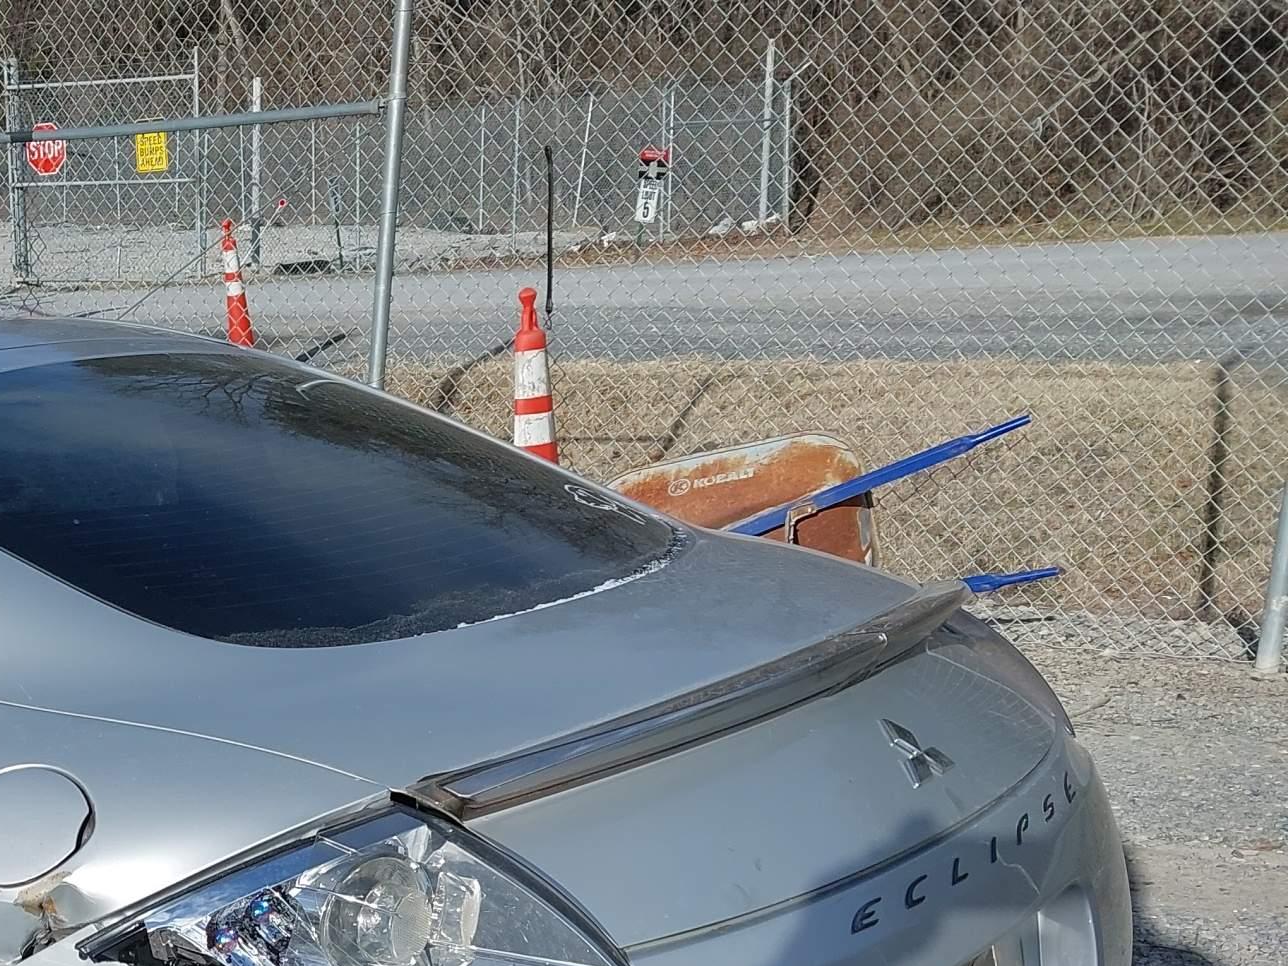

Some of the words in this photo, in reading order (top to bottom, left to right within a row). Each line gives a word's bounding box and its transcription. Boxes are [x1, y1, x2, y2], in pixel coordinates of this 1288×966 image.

[139, 135, 162, 146] SPEED
[29, 140, 62, 160] STOP
[139, 146, 164, 157] BUMPS
[140, 156, 164, 168] AHEAD
[642, 201, 650, 219] 5
[693, 467, 755, 489] KOBALT
[850, 771, 1077, 936] ECLIPSE
